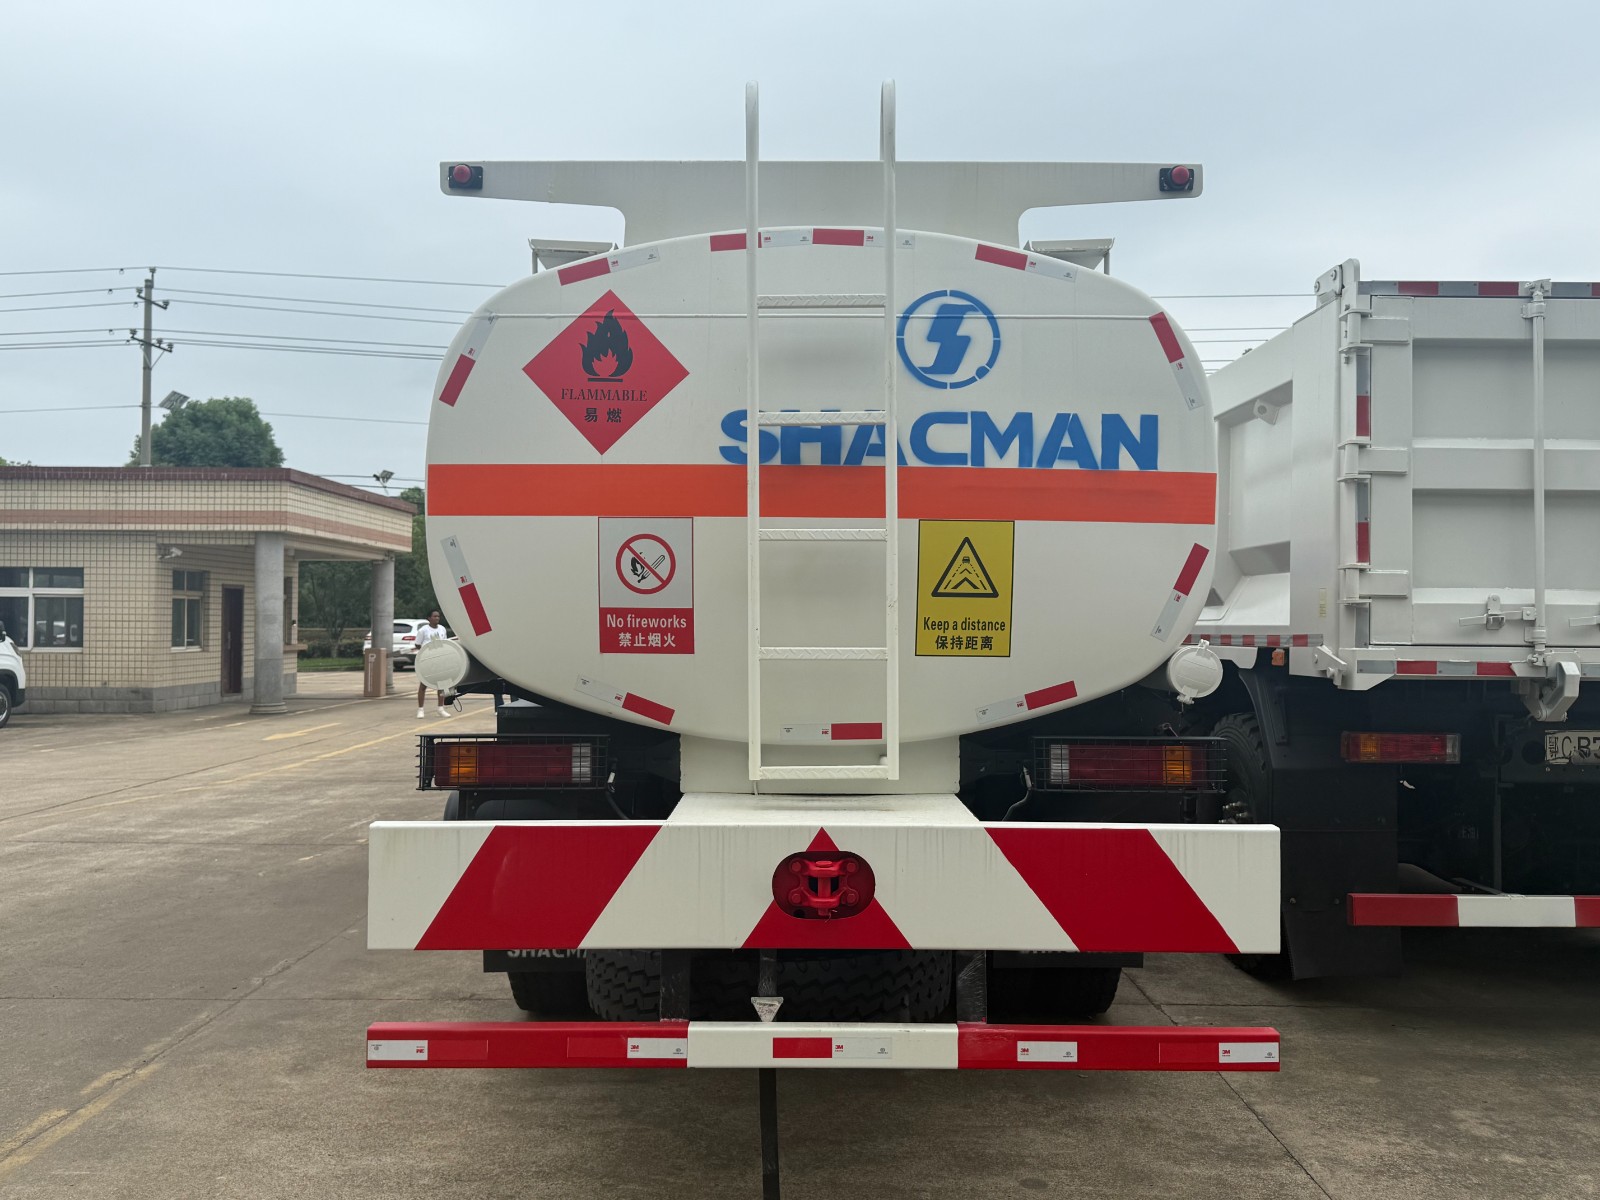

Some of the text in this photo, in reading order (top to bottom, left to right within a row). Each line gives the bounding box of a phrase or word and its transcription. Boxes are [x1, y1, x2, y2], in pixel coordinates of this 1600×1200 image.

[561, 388, 648, 402] FLAMMABLE
[585, 407, 622, 423] 易燃
[719, 409, 1159, 471] SHACMAN
[606, 613, 687, 629] No fireworks
[923, 616, 1006, 634] Keep a distance
[618, 632, 676, 647] 禁止烟火
[935, 635, 994, 651] 保持距离
